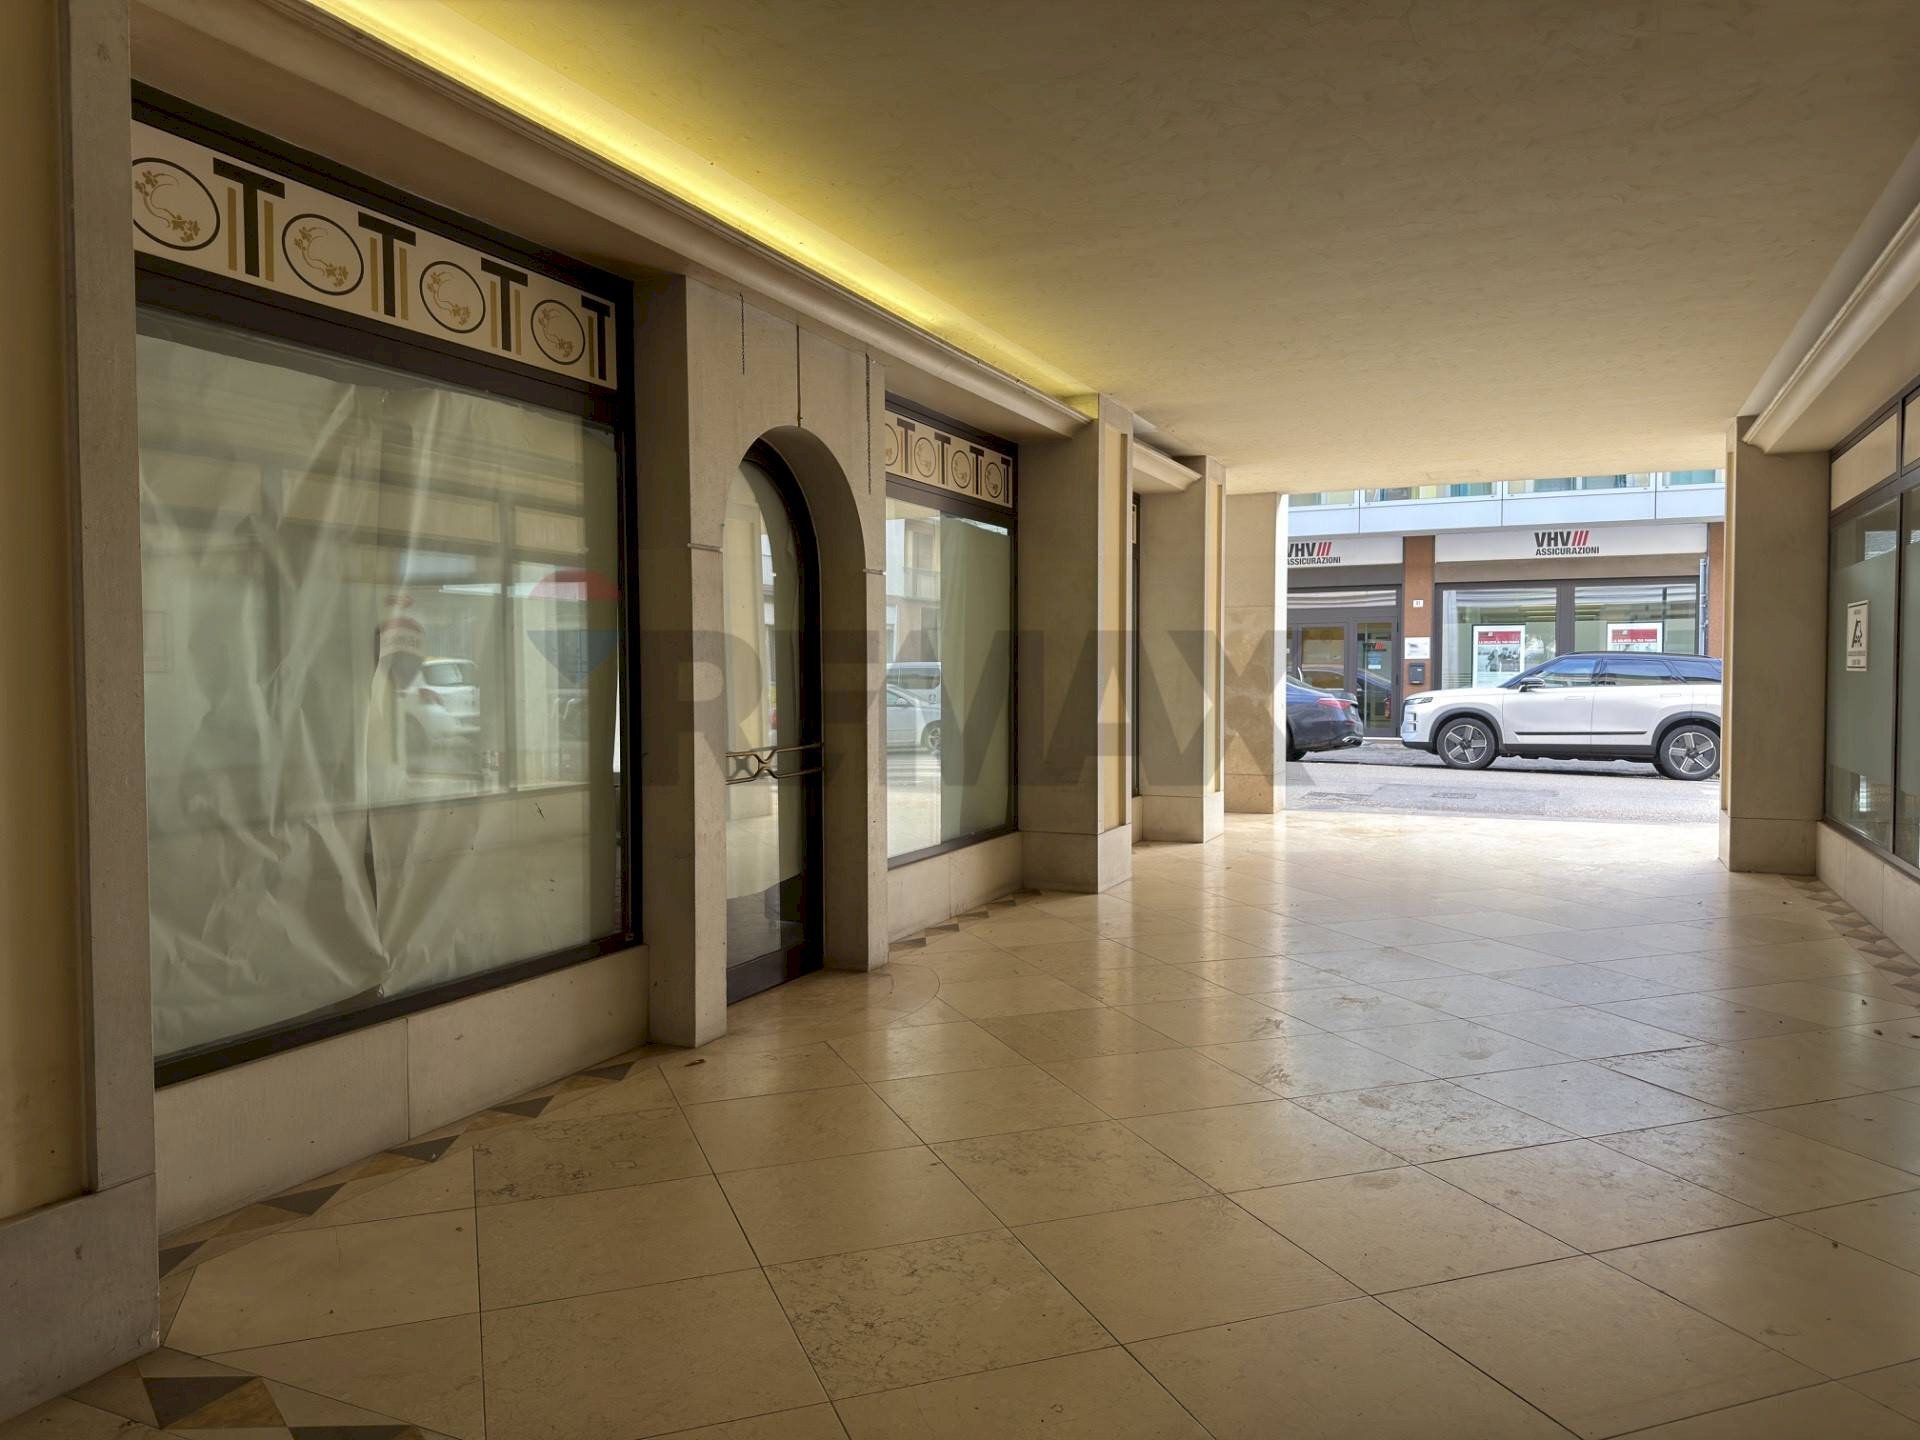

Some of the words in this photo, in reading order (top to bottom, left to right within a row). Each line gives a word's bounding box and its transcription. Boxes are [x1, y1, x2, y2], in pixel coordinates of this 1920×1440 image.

[1534, 531, 1571, 548] VHV
[1535, 546, 1600, 556] ASSICURAZIONI
[1288, 556, 1341, 566] SSICURAZIONI
